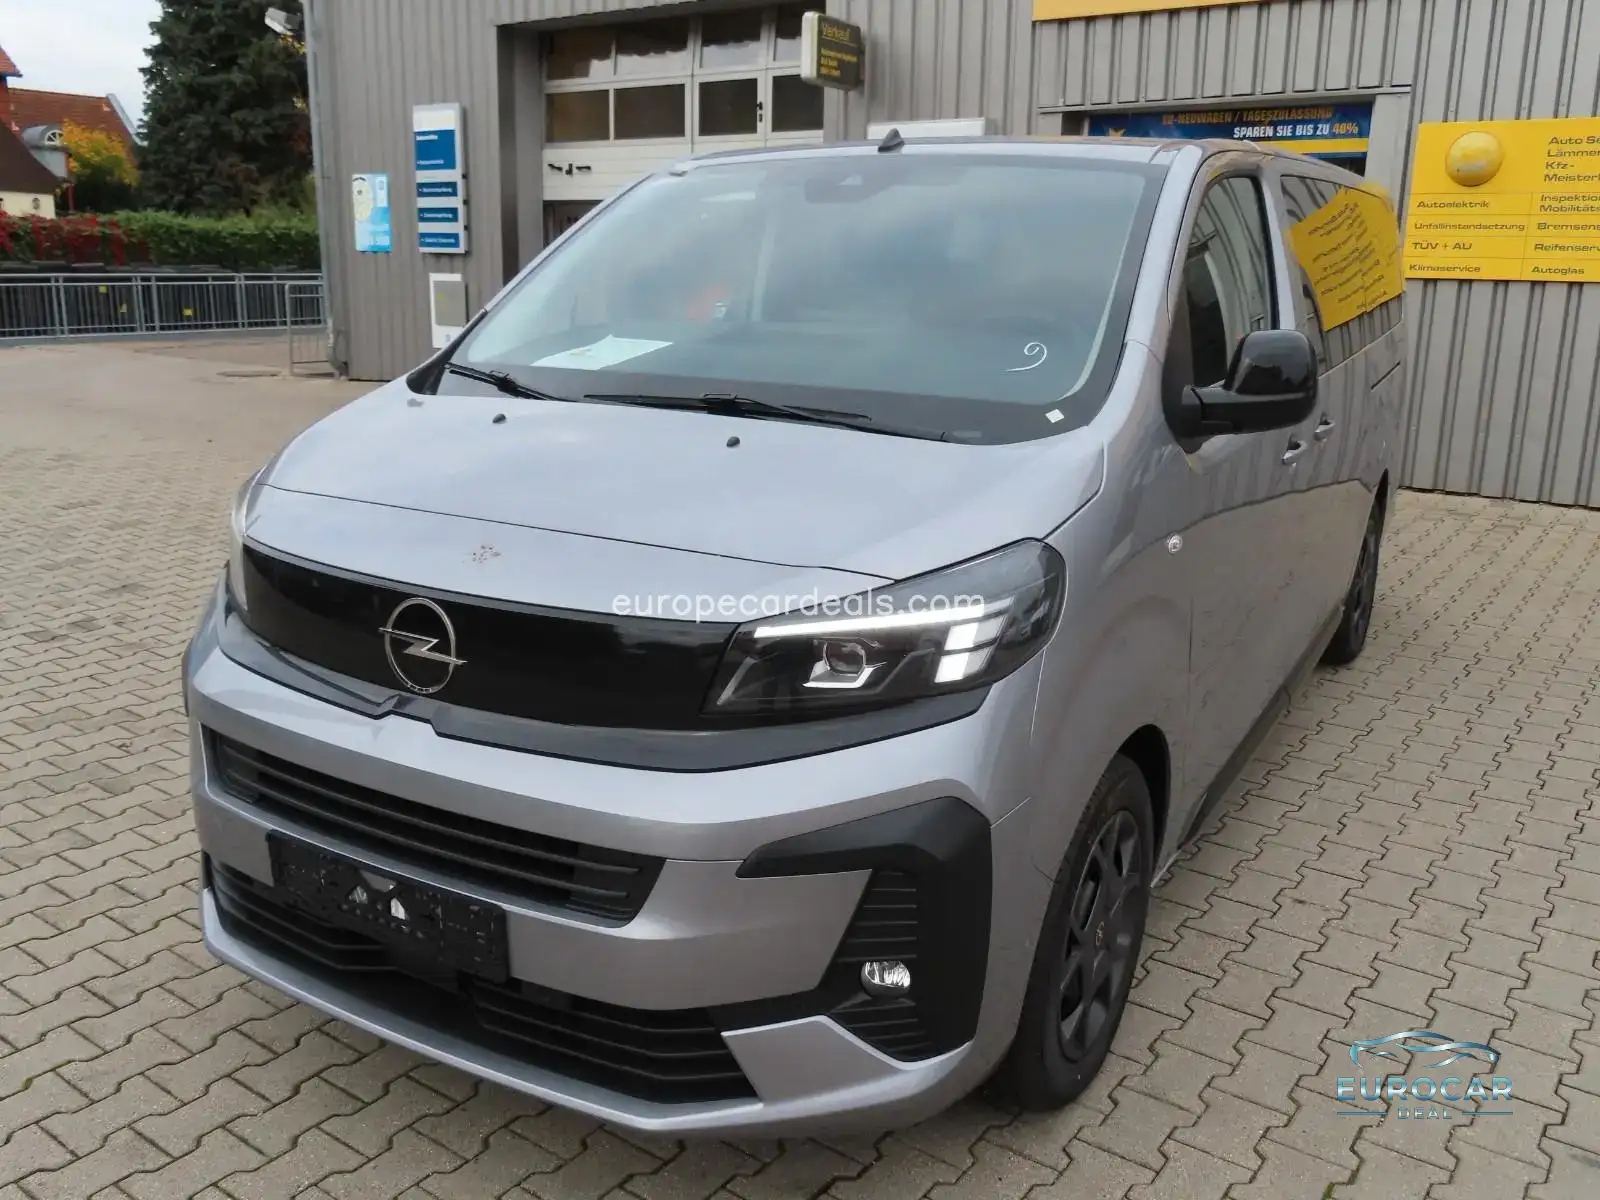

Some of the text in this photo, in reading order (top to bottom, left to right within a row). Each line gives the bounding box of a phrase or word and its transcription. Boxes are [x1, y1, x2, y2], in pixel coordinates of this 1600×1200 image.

[1243, 107, 1333, 122] TAGESZULASSUNG
[1233, 123, 1359, 138] SPAREN SIE BIS ZU 40%
[1548, 136, 1583, 145] Auto
[1543, 173, 1600, 182] Meister
[1540, 194, 1600, 204] Inspektio
[1417, 201, 1490, 209] Autoelektrik
[1414, 222, 1526, 232] Unfallinstandsetzung
[1411, 240, 1440, 250] TÜV
[1452, 242, 1473, 250] AU
[1409, 264, 1481, 273] Klimaservice
[1531, 266, 1585, 276] Autoglas
